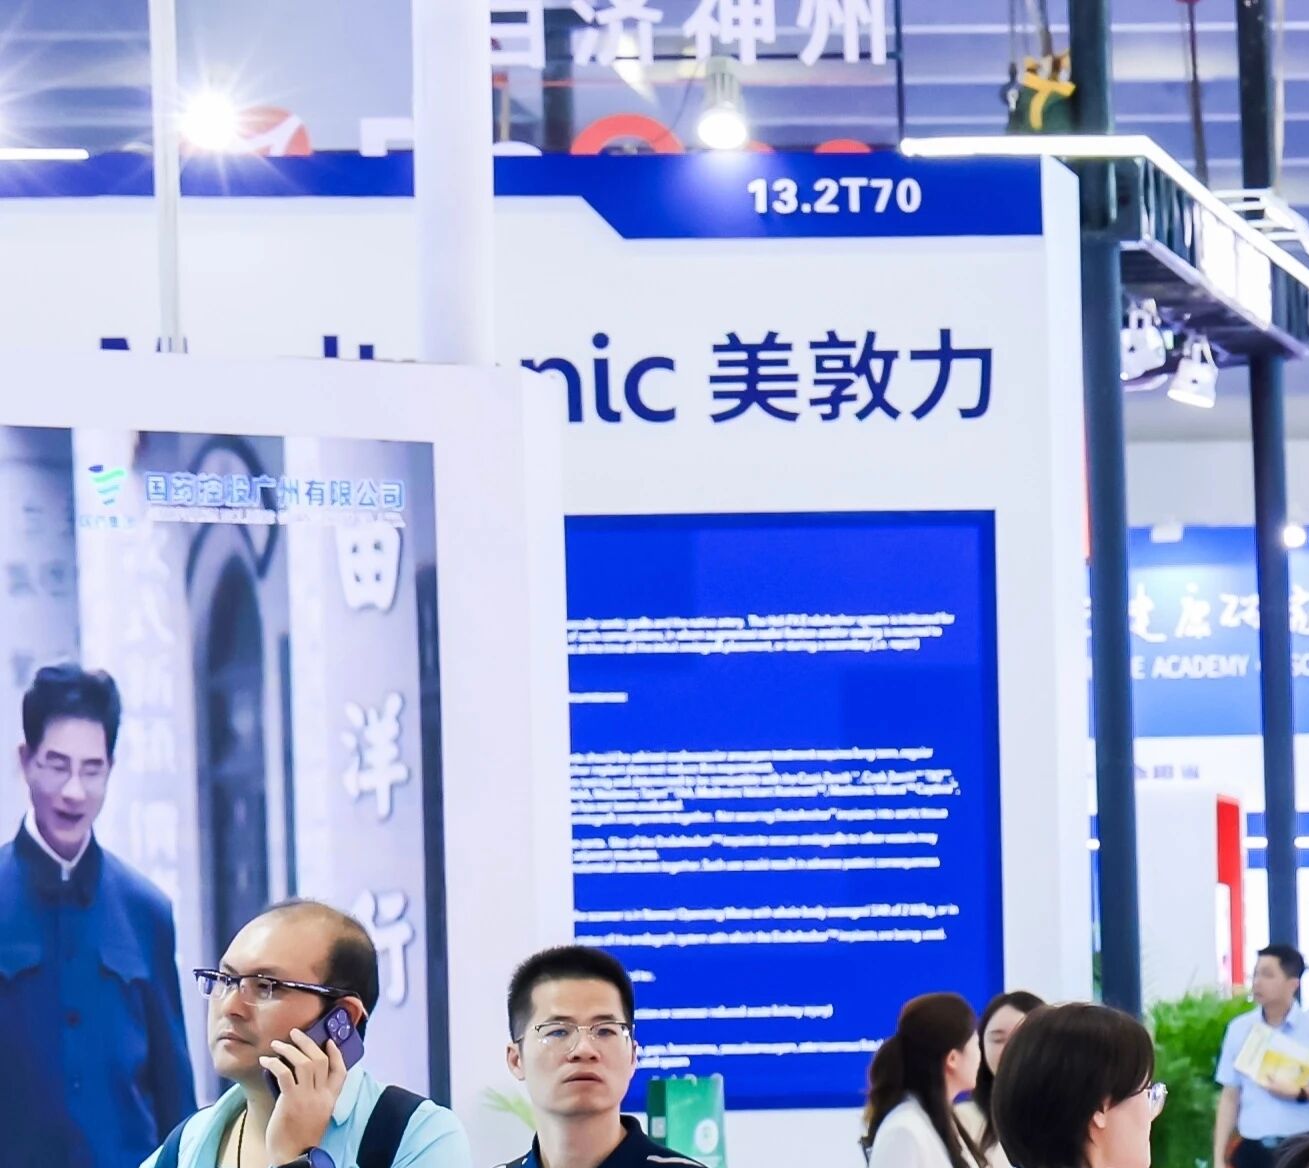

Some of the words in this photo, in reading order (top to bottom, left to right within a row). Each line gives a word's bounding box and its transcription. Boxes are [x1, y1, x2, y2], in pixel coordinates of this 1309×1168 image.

[746, 177, 923, 215] 13.2T70
[708, 328, 994, 423] 美敦力
[146, 472, 406, 510] 国药控股广州有限公司
[1151, 653, 1251, 681] ACADEMY
